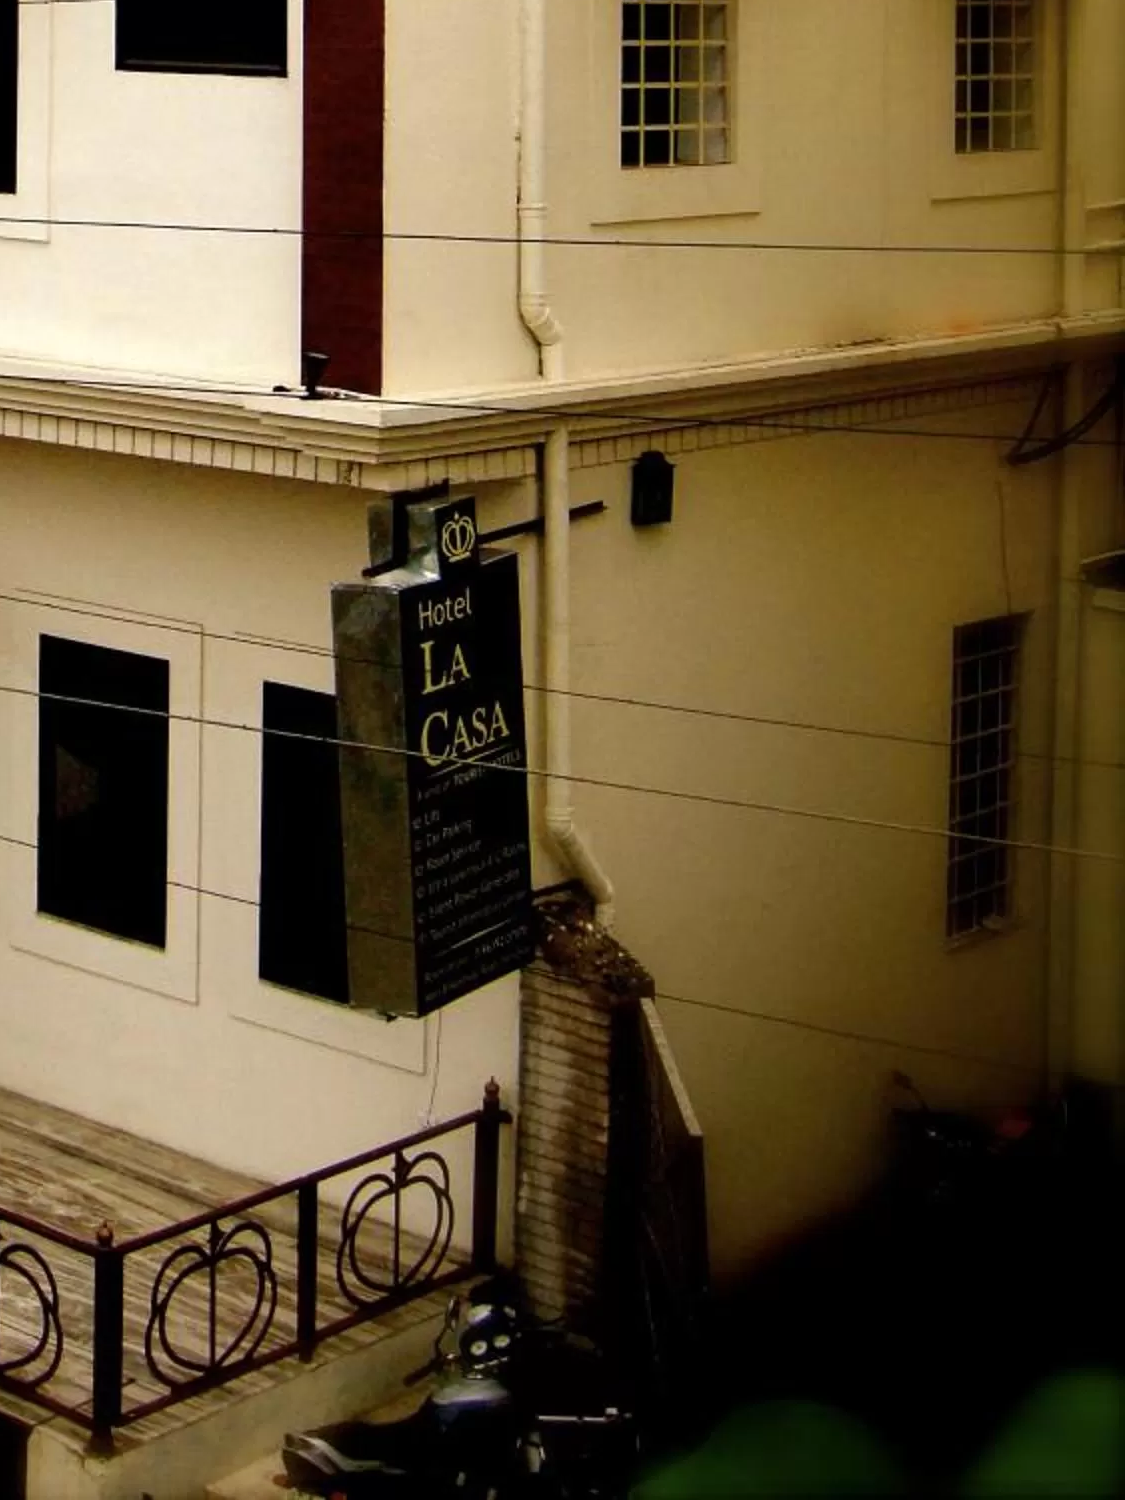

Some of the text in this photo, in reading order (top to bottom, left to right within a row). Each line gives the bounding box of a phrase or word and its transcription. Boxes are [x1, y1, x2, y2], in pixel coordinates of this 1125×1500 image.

[418, 586, 472, 630] Hotel
[420, 640, 471, 695] LA
[421, 700, 510, 767] CASA
